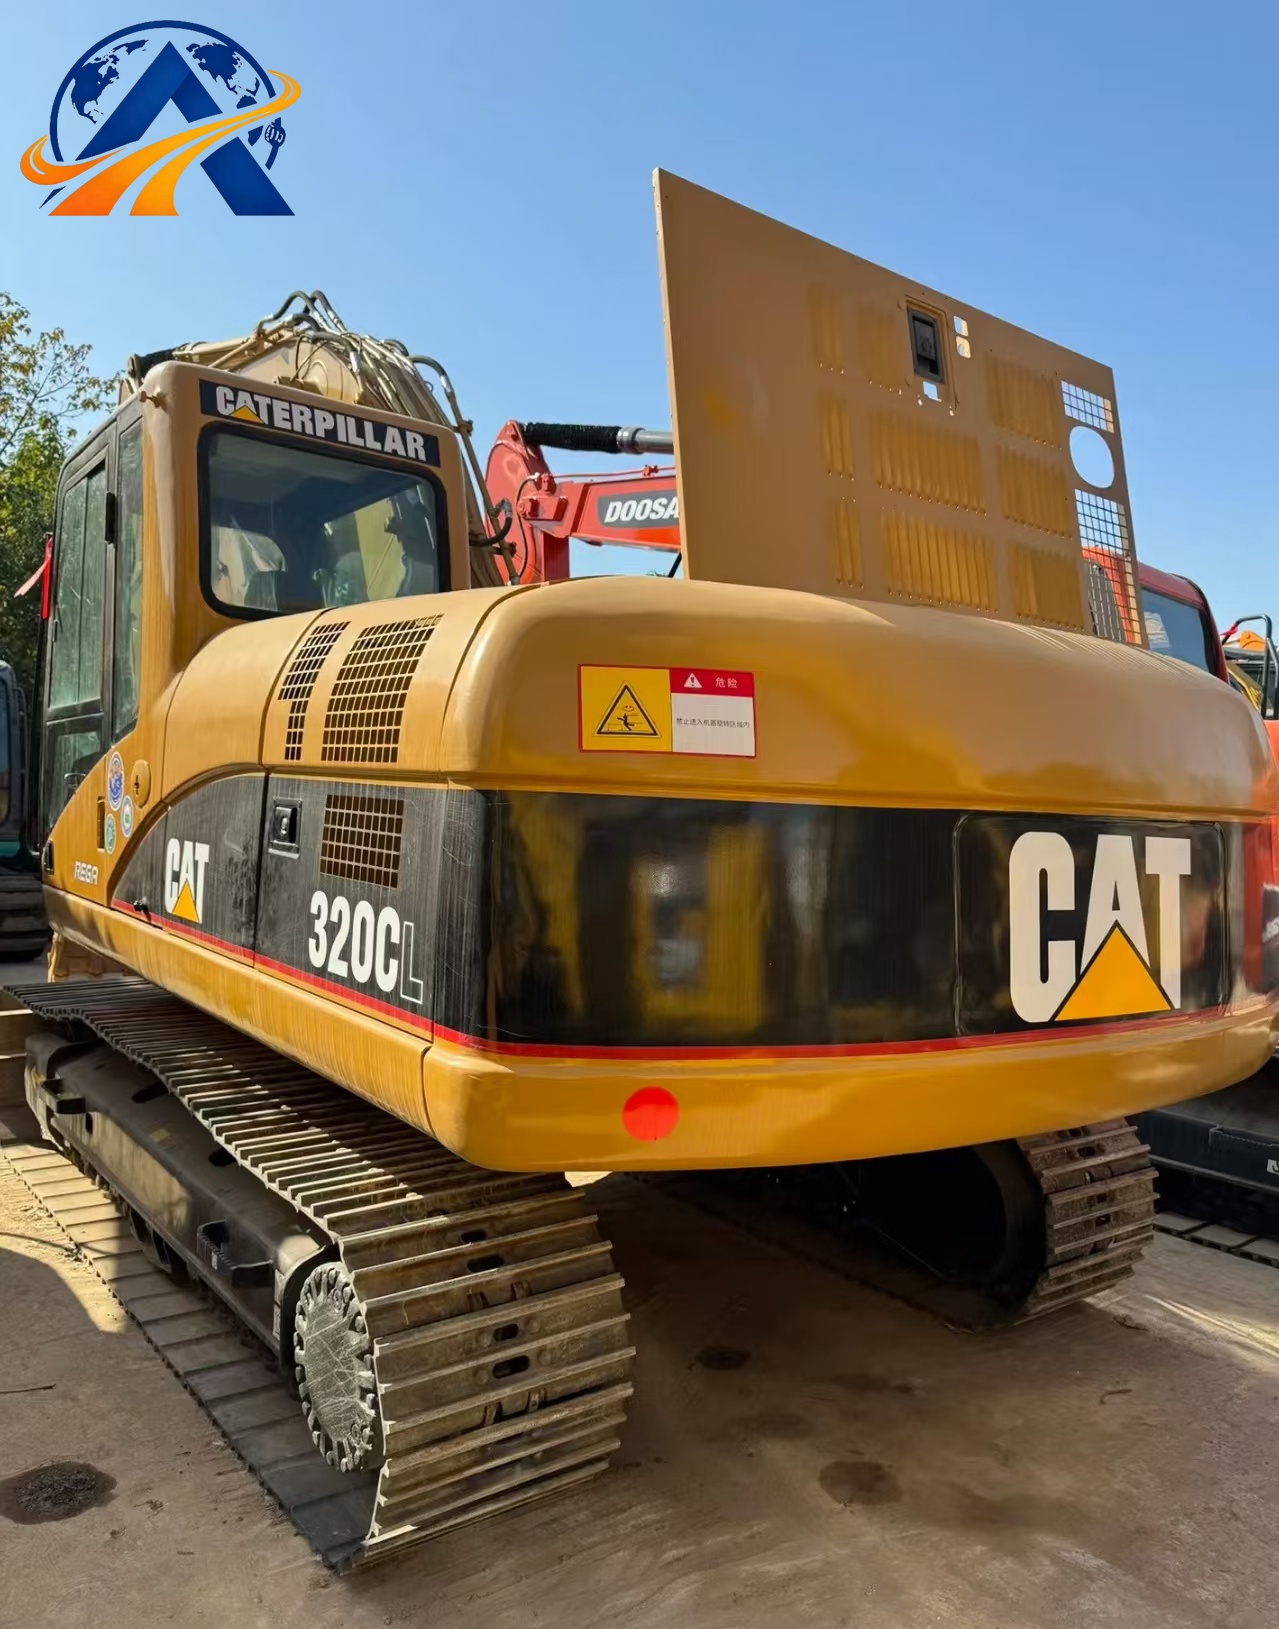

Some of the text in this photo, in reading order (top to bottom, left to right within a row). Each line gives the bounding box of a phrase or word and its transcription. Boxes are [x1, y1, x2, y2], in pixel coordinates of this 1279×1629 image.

[215, 386, 427, 463] CATERPILLAR
[715, 677, 738, 689] 危险
[164, 838, 210, 924] CAT
[1009, 831, 1191, 1023] CAT
